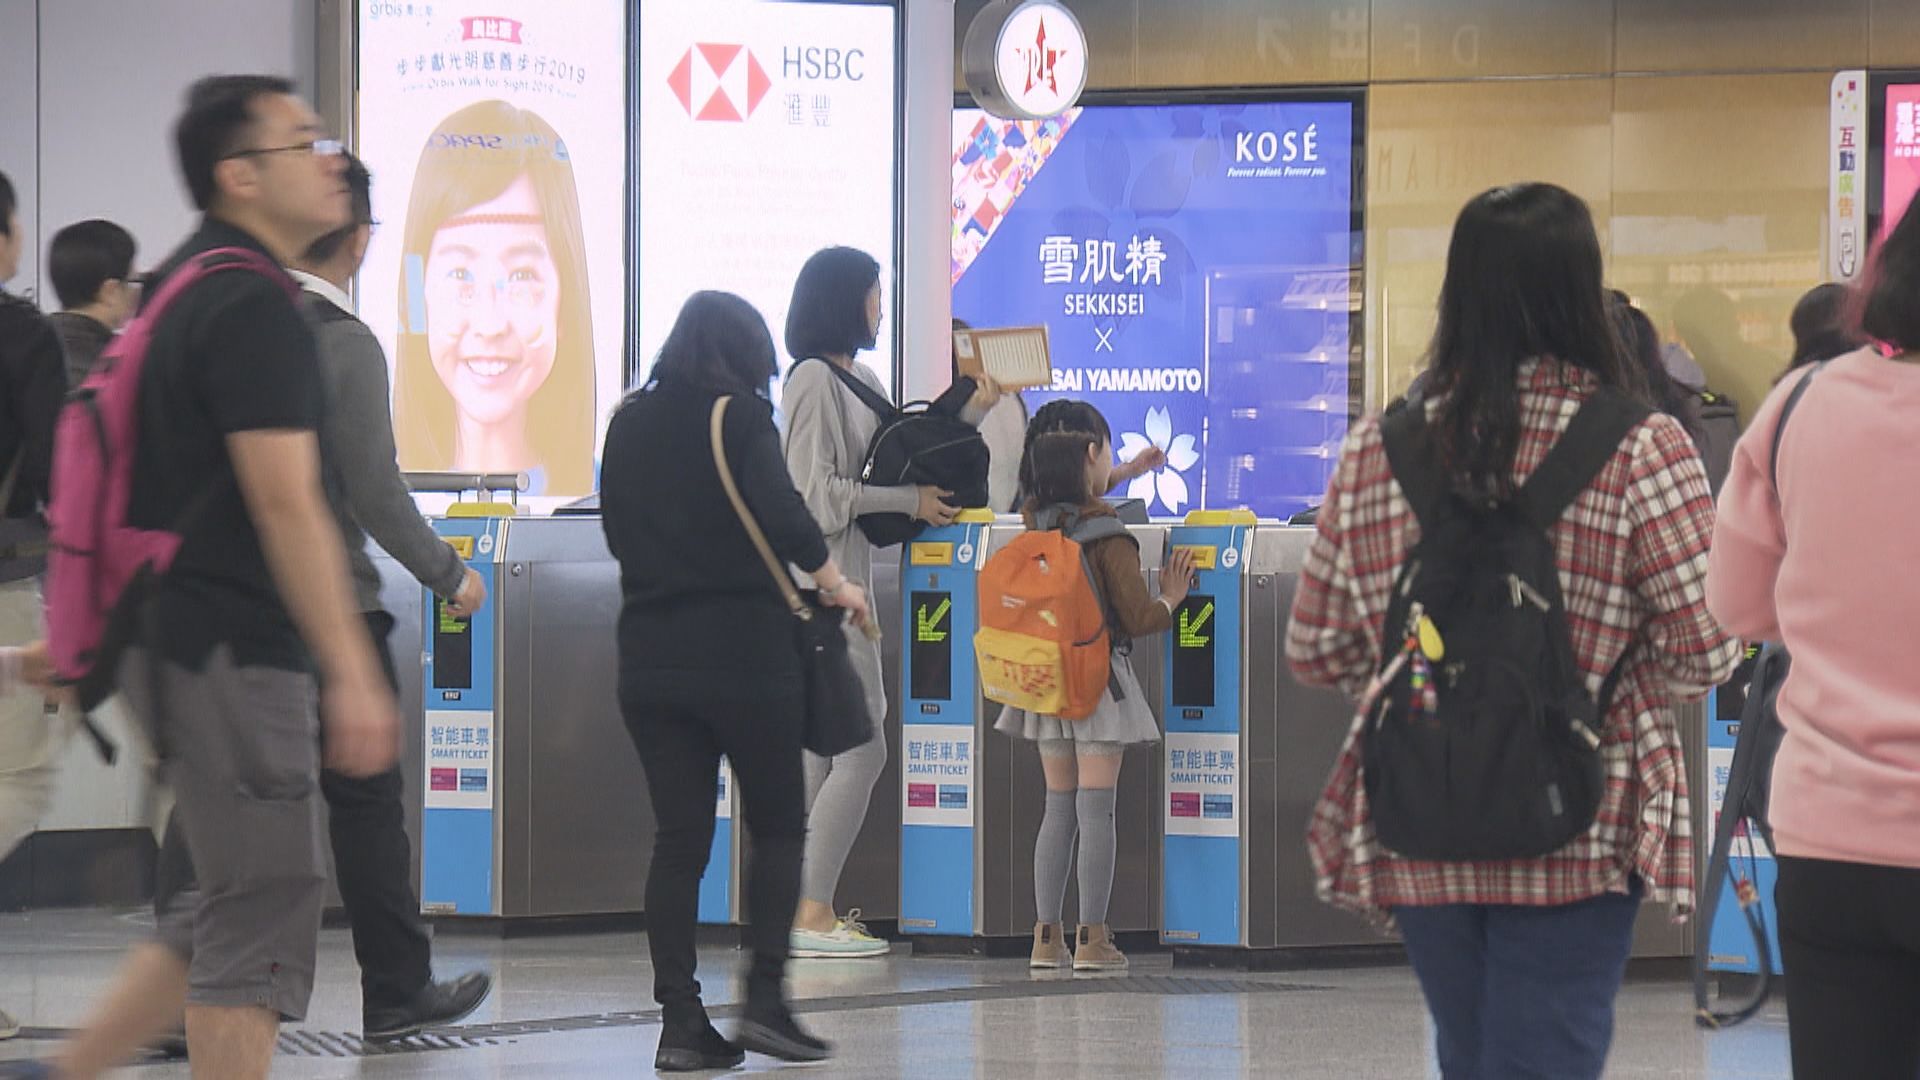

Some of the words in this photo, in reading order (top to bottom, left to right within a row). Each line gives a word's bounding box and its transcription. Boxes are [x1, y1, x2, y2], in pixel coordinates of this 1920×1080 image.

[782, 46, 865, 81] HSBC
[458, 76, 481, 87] Walk
[1235, 122, 1319, 162] KOSÉ
[1038, 235, 1168, 286] 雪肌精
[1064, 294, 1145, 316] SEKKISEI
[1085, 367, 1202, 392] YAMAMOTO
[431, 725, 489, 746] 智能車票
[431, 748, 459, 759] SMART
[460, 749, 489, 760] TICKET
[907, 740, 969, 761] 智能車票
[1169, 749, 1234, 770] 智能車票
[908, 763, 937, 774] SMART
[939, 765, 968, 776] TICKET
[1170, 772, 1201, 784] SMART
[1203, 774, 1233, 785] TICKET
